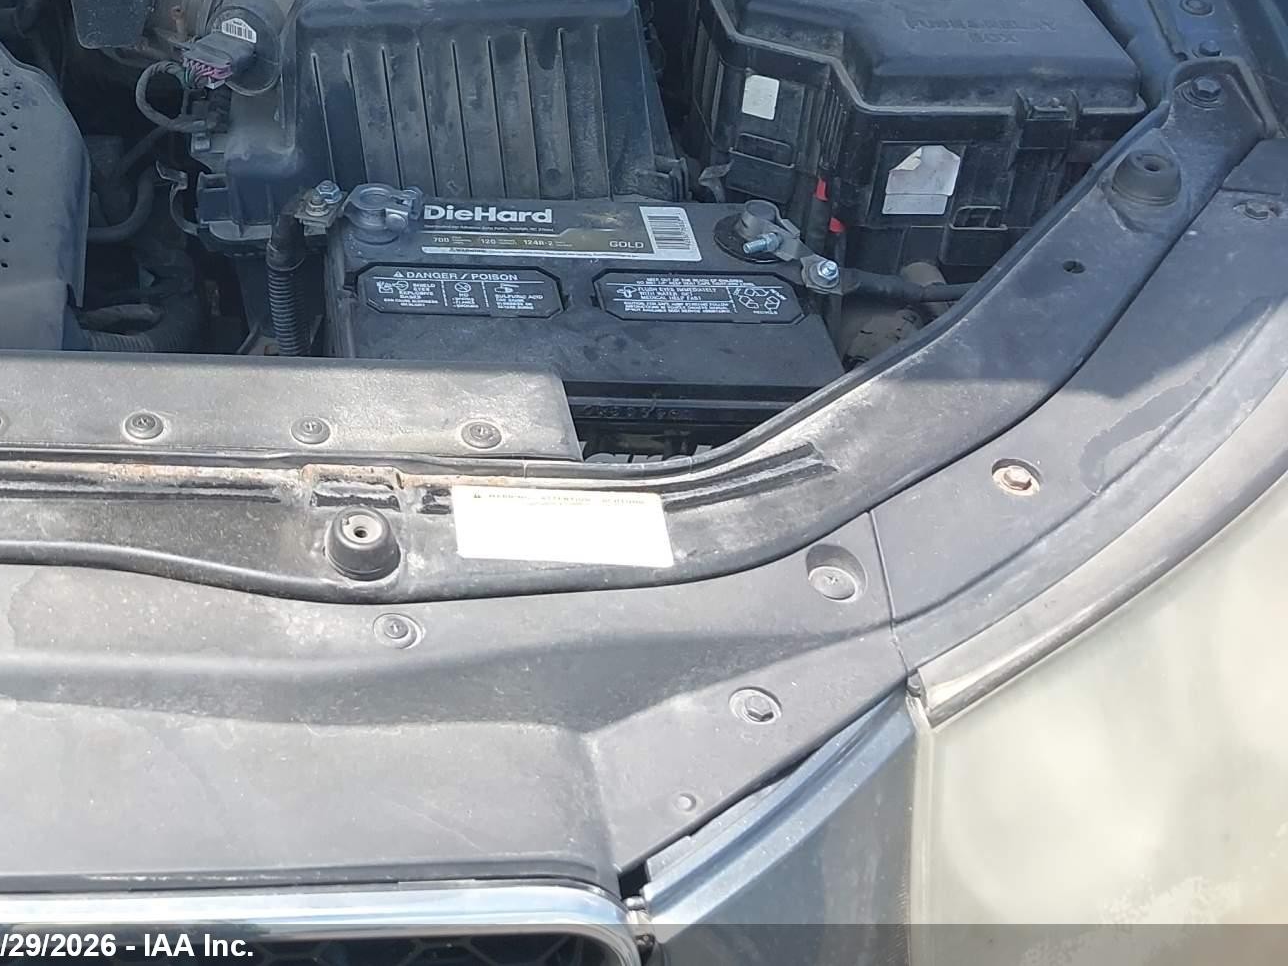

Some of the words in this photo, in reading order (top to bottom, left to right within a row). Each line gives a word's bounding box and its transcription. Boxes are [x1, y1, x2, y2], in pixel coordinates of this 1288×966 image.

[423, 204, 553, 224] DieHard
[609, 240, 644, 249] GOLD
[406, 271, 458, 280] DANGER
[471, 273, 518, 281] POISON
